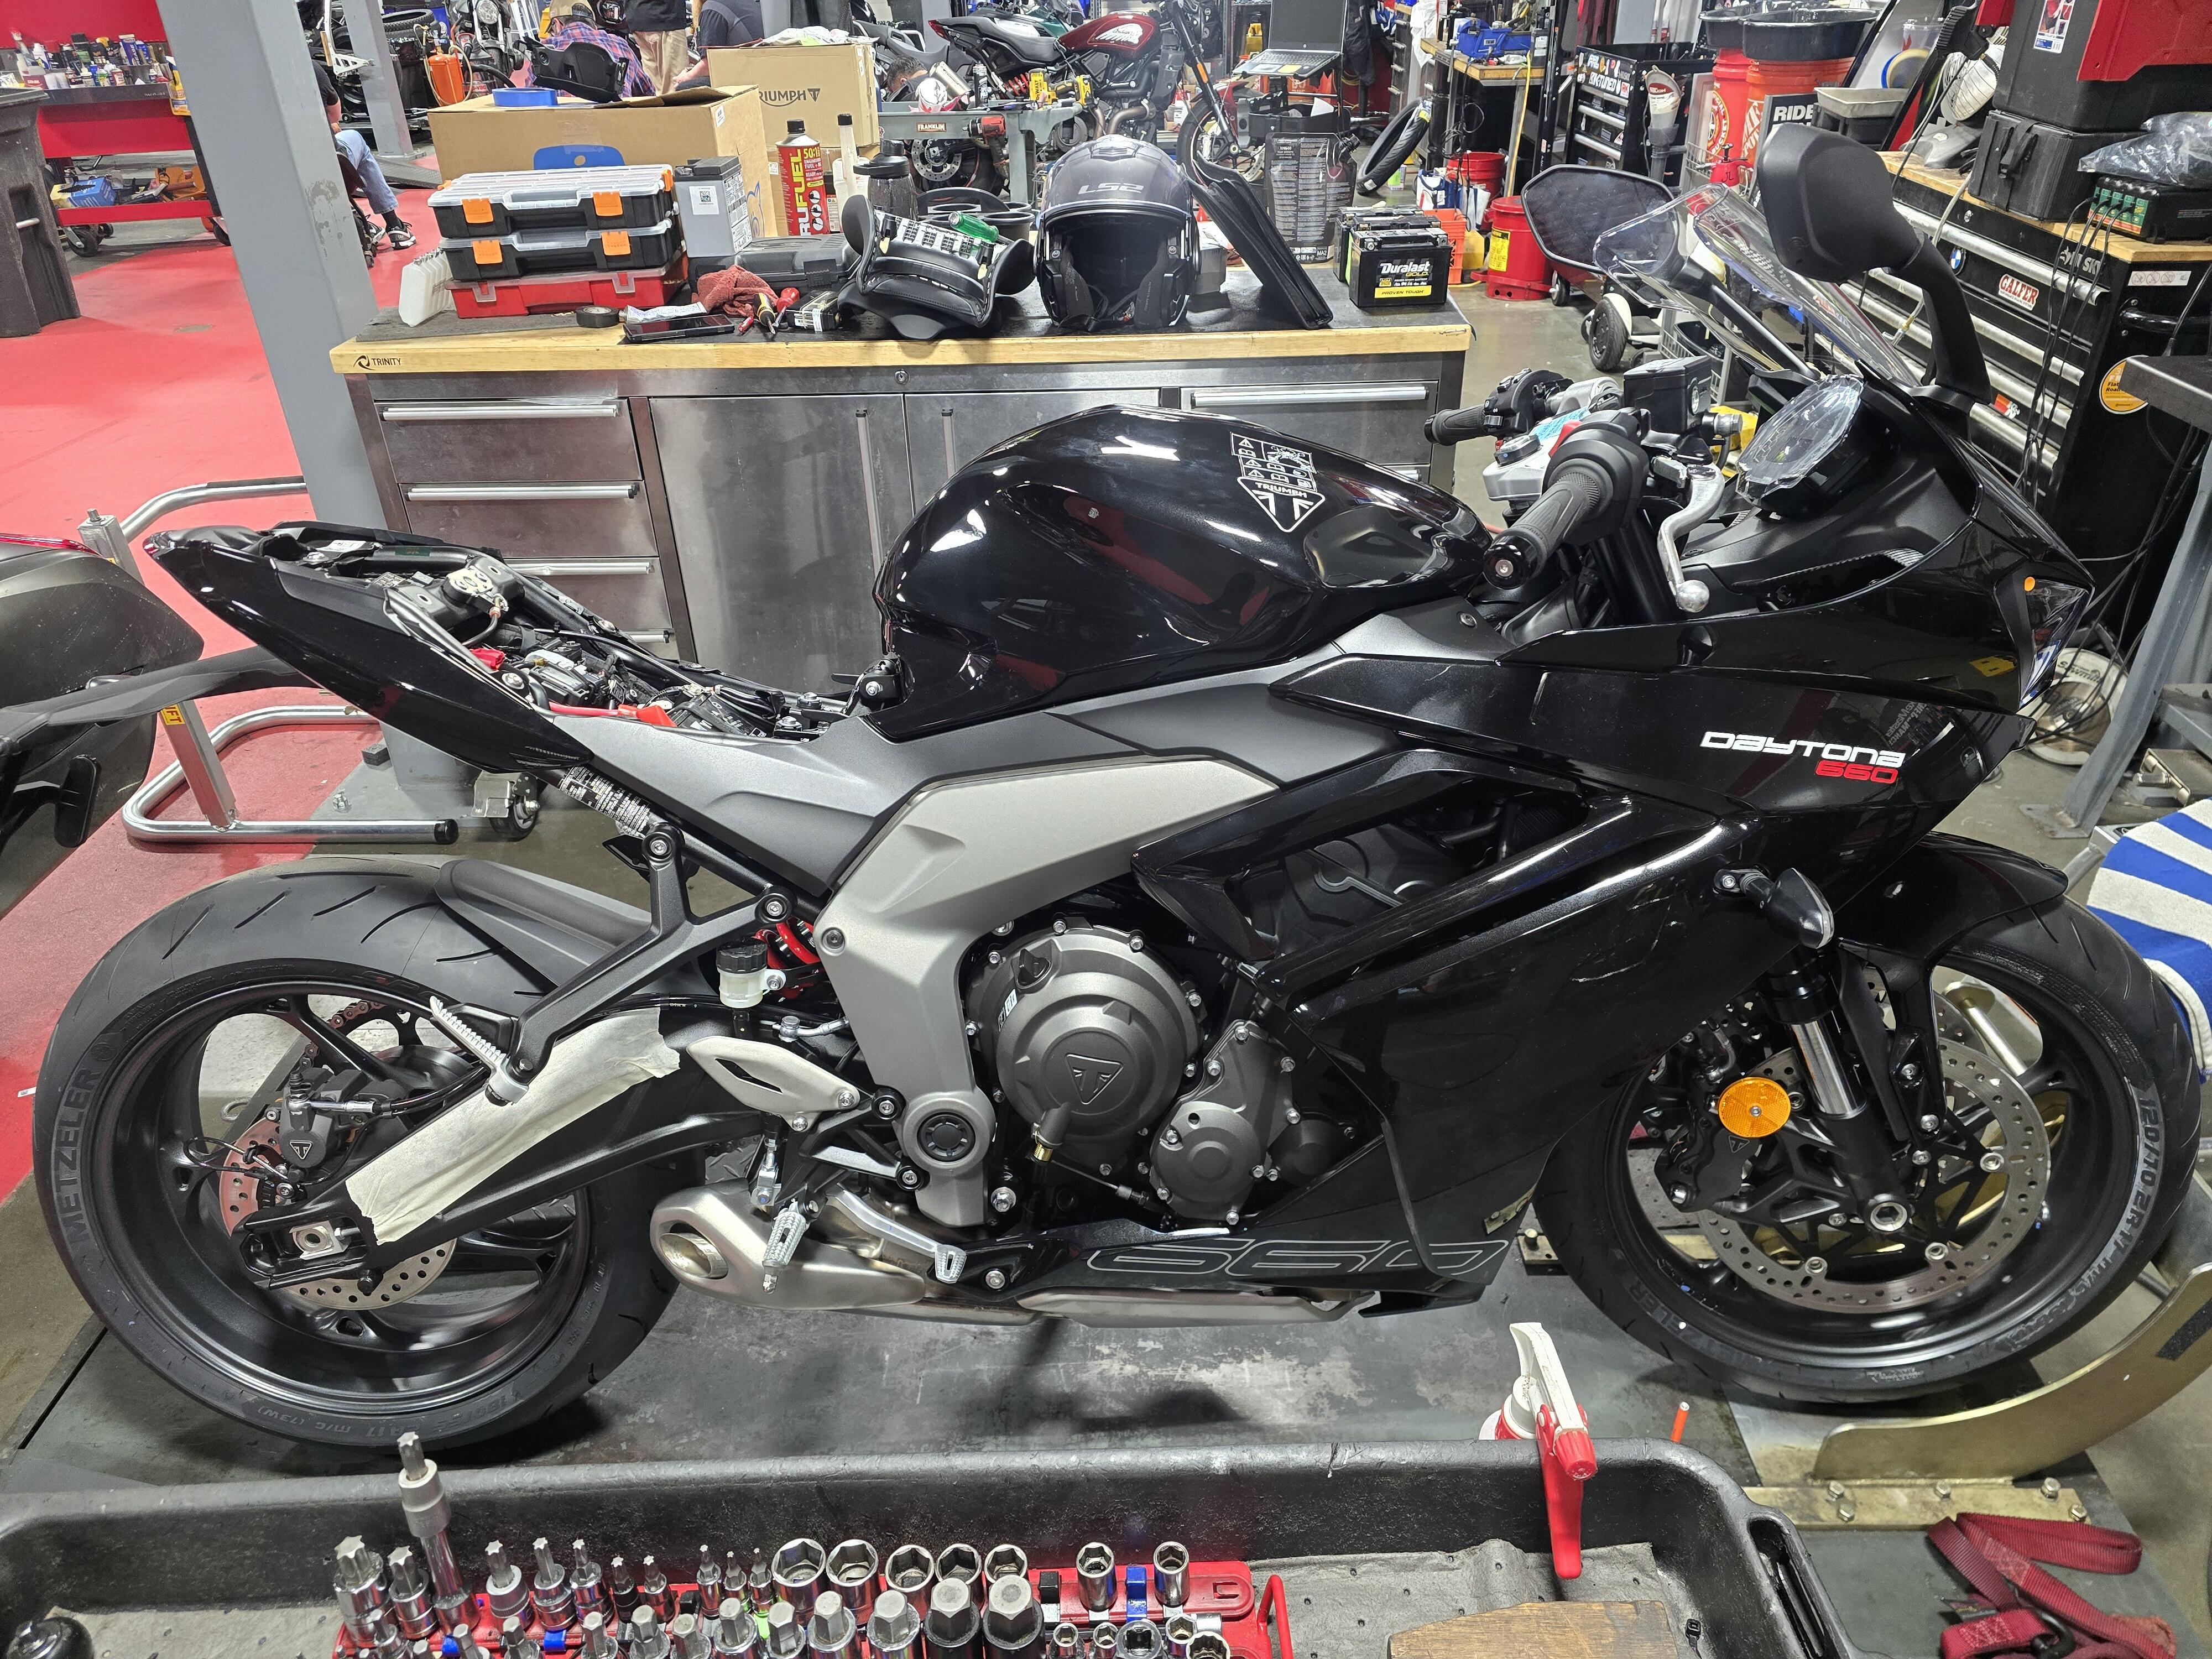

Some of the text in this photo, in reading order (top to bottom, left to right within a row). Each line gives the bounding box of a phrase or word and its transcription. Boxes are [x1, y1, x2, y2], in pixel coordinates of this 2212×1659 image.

[759, 90, 807, 104] RIUMPH
[165, 153, 182, 169] IFT
[804, 147, 818, 159] 50:1
[790, 149, 812, 236] RUFUEL
[1078, 182, 1144, 195] LS2
[1380, 260, 1431, 274] Duralast
[2000, 275, 2039, 305] GALFER
[1255, 482, 1307, 498] TRIUMPH
[1815, 759, 1898, 784] 660
[55, 1068, 102, 1244] METZELER
[1087, 1238, 1509, 1276] 660
